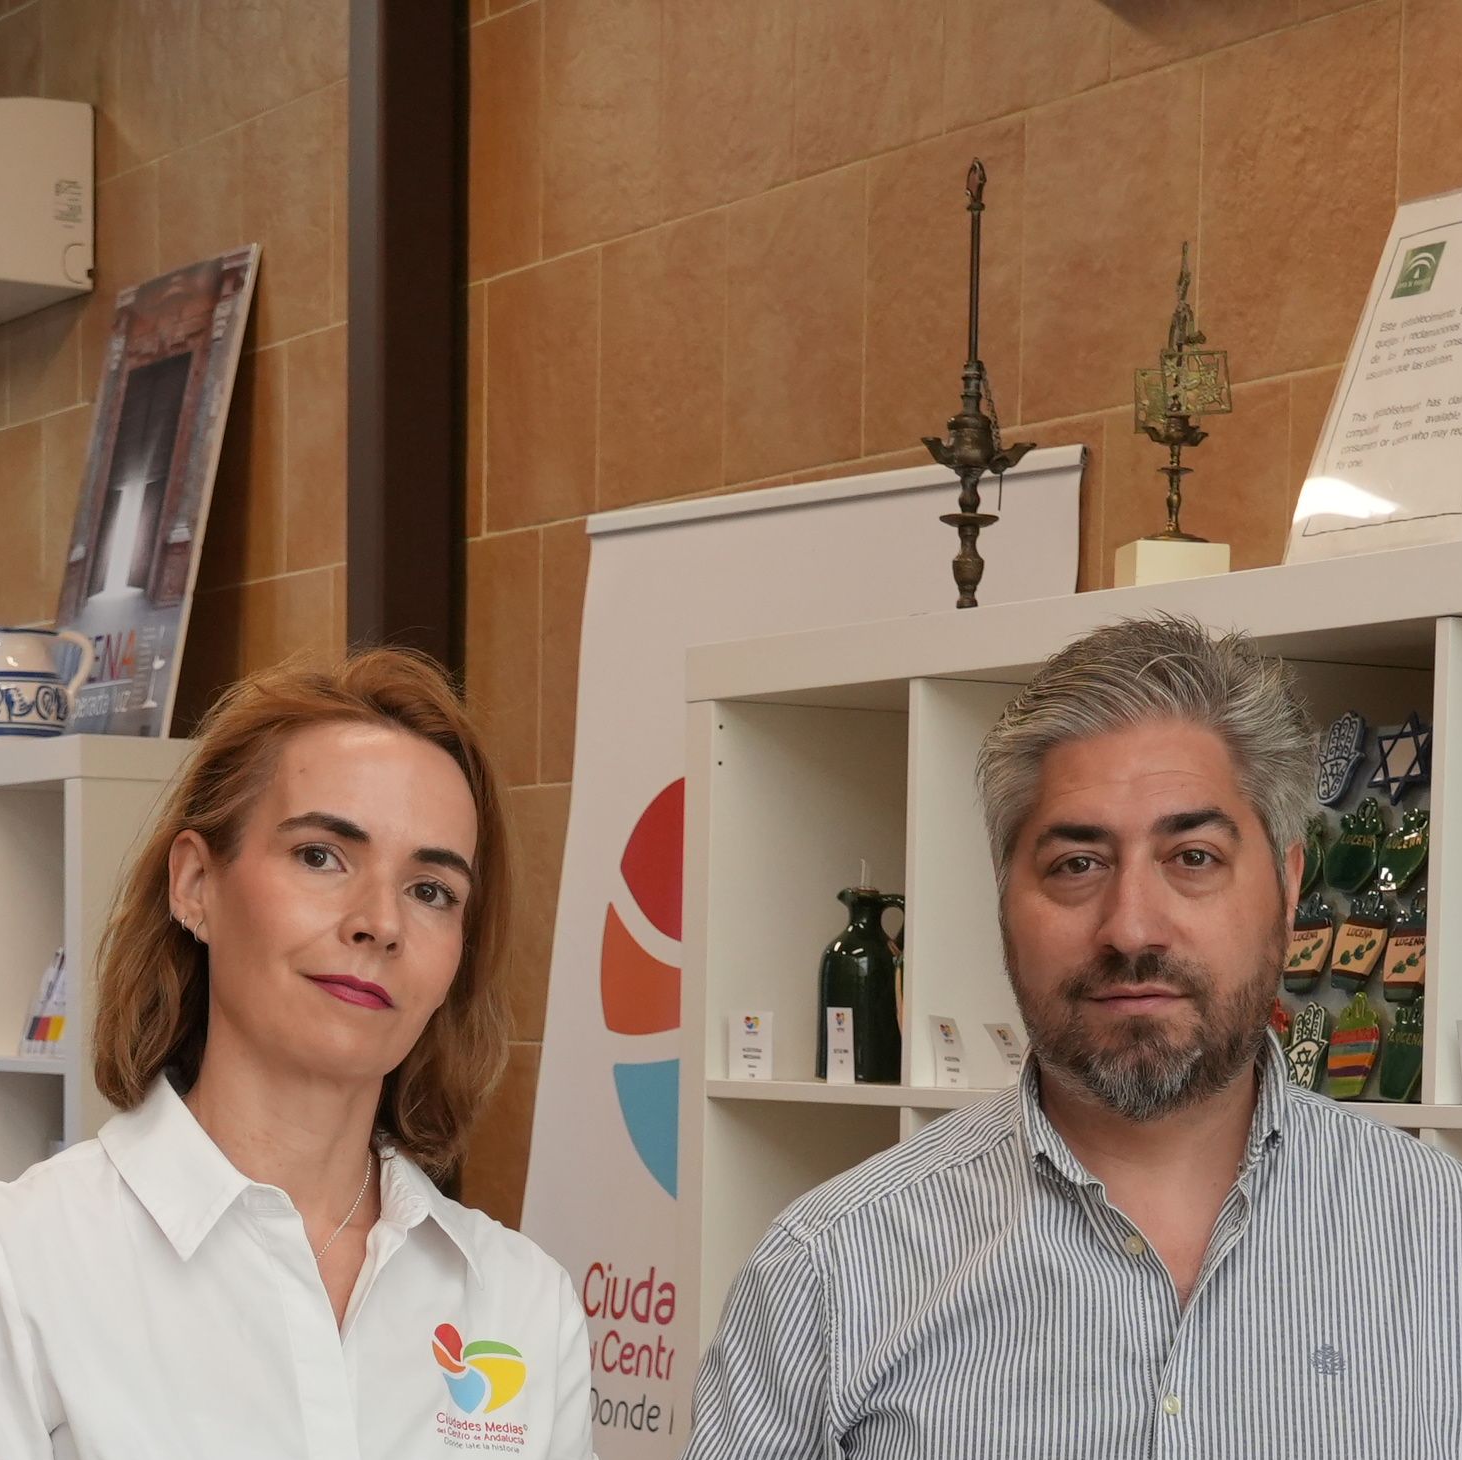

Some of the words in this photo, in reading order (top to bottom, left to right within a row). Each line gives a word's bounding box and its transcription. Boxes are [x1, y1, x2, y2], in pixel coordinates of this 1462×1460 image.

[583, 1262, 676, 1326] Ciuda
[436, 1411, 482, 1433] Ciudades
[447, 1427, 470, 1441] Centro
